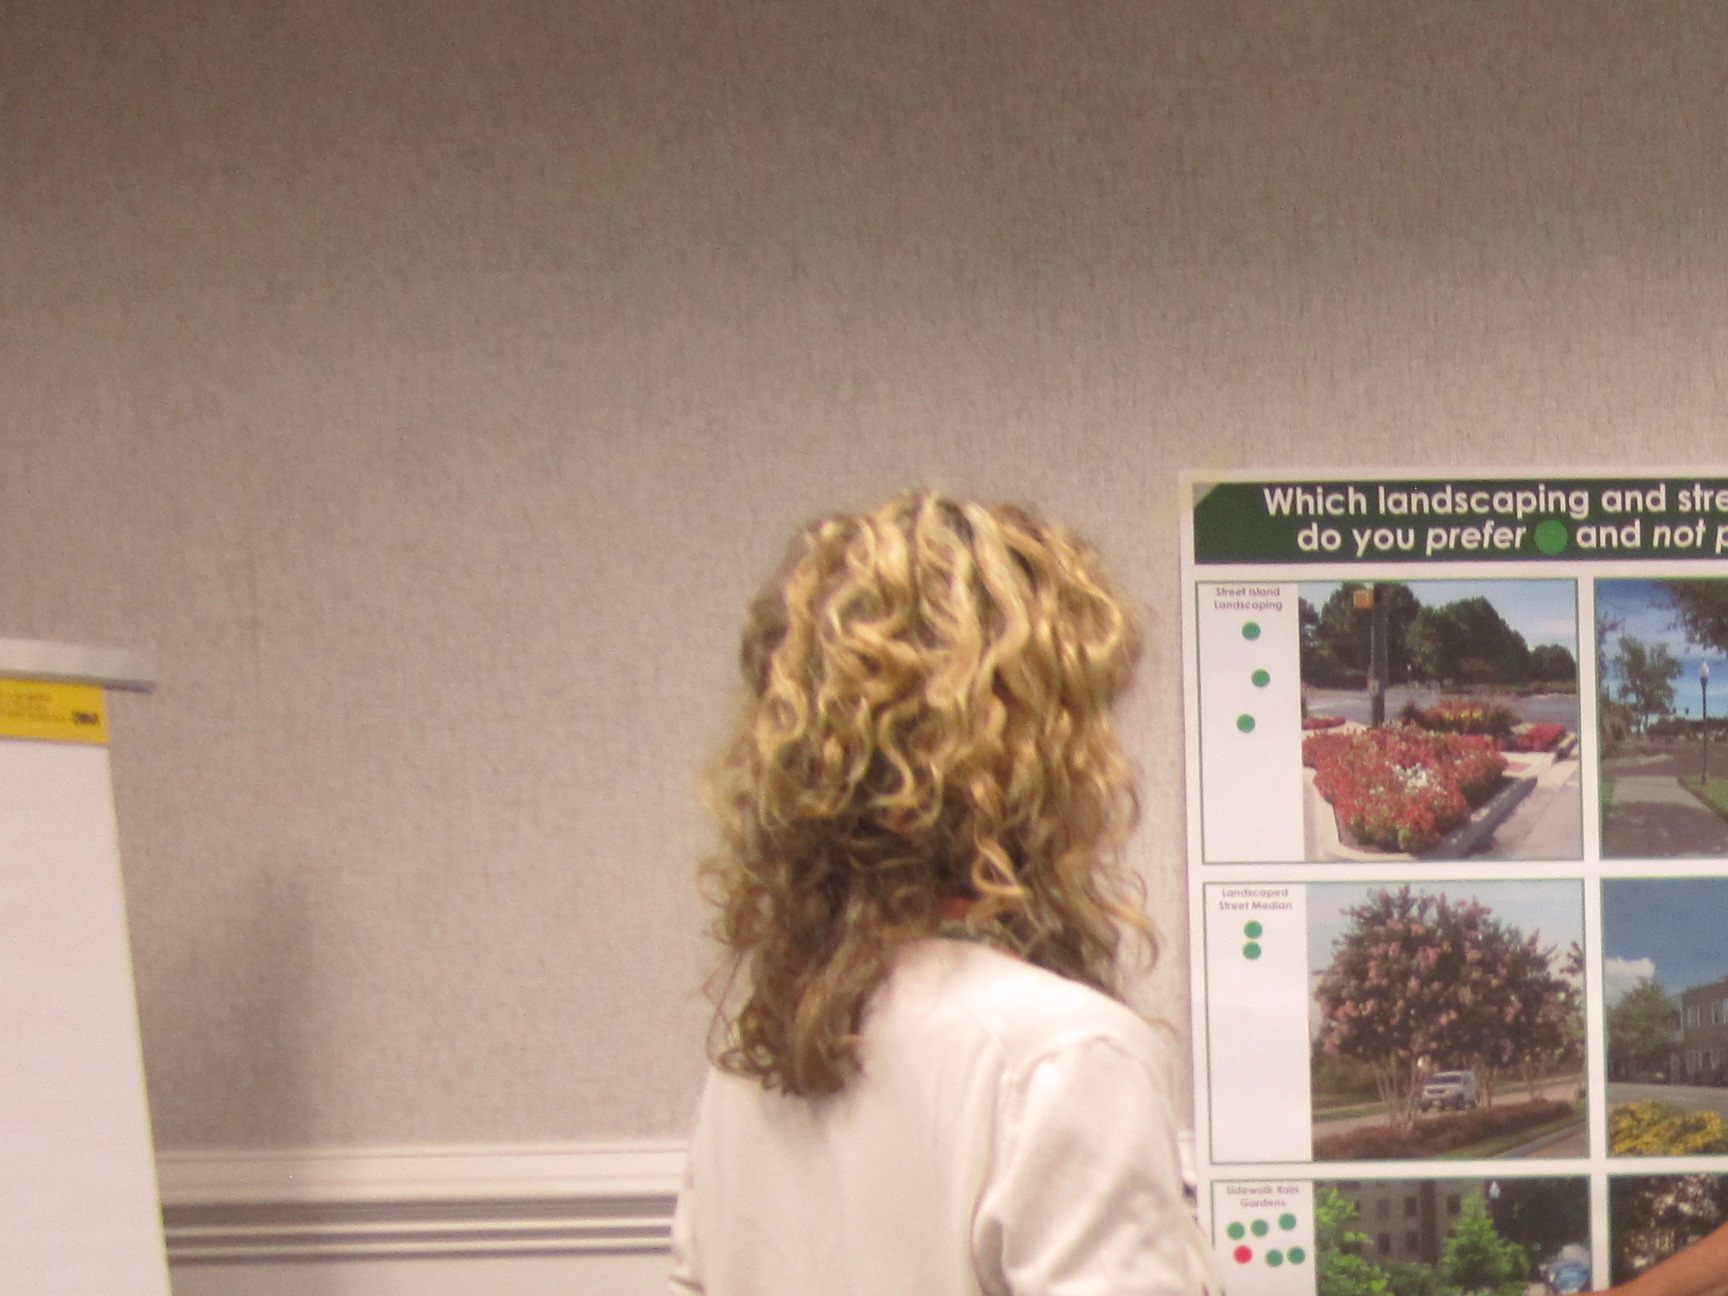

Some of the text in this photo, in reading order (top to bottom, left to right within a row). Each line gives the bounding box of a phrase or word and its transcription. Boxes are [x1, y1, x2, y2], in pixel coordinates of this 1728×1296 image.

[1263, 485, 1367, 516] Which
[1378, 484, 1590, 520] landscaping
[1601, 483, 1666, 513] and
[1296, 521, 1342, 551] do
[1351, 527, 1415, 557] you
[1425, 520, 1527, 556] prefer
[1576, 519, 1642, 549] and
[1652, 519, 1707, 548] not
[1216, 586, 1279, 596] Street Island
[1214, 600, 1282, 610] Landscaping
[1222, 888, 1288, 898] Landscaped
[1219, 901, 1292, 910] Street Median
